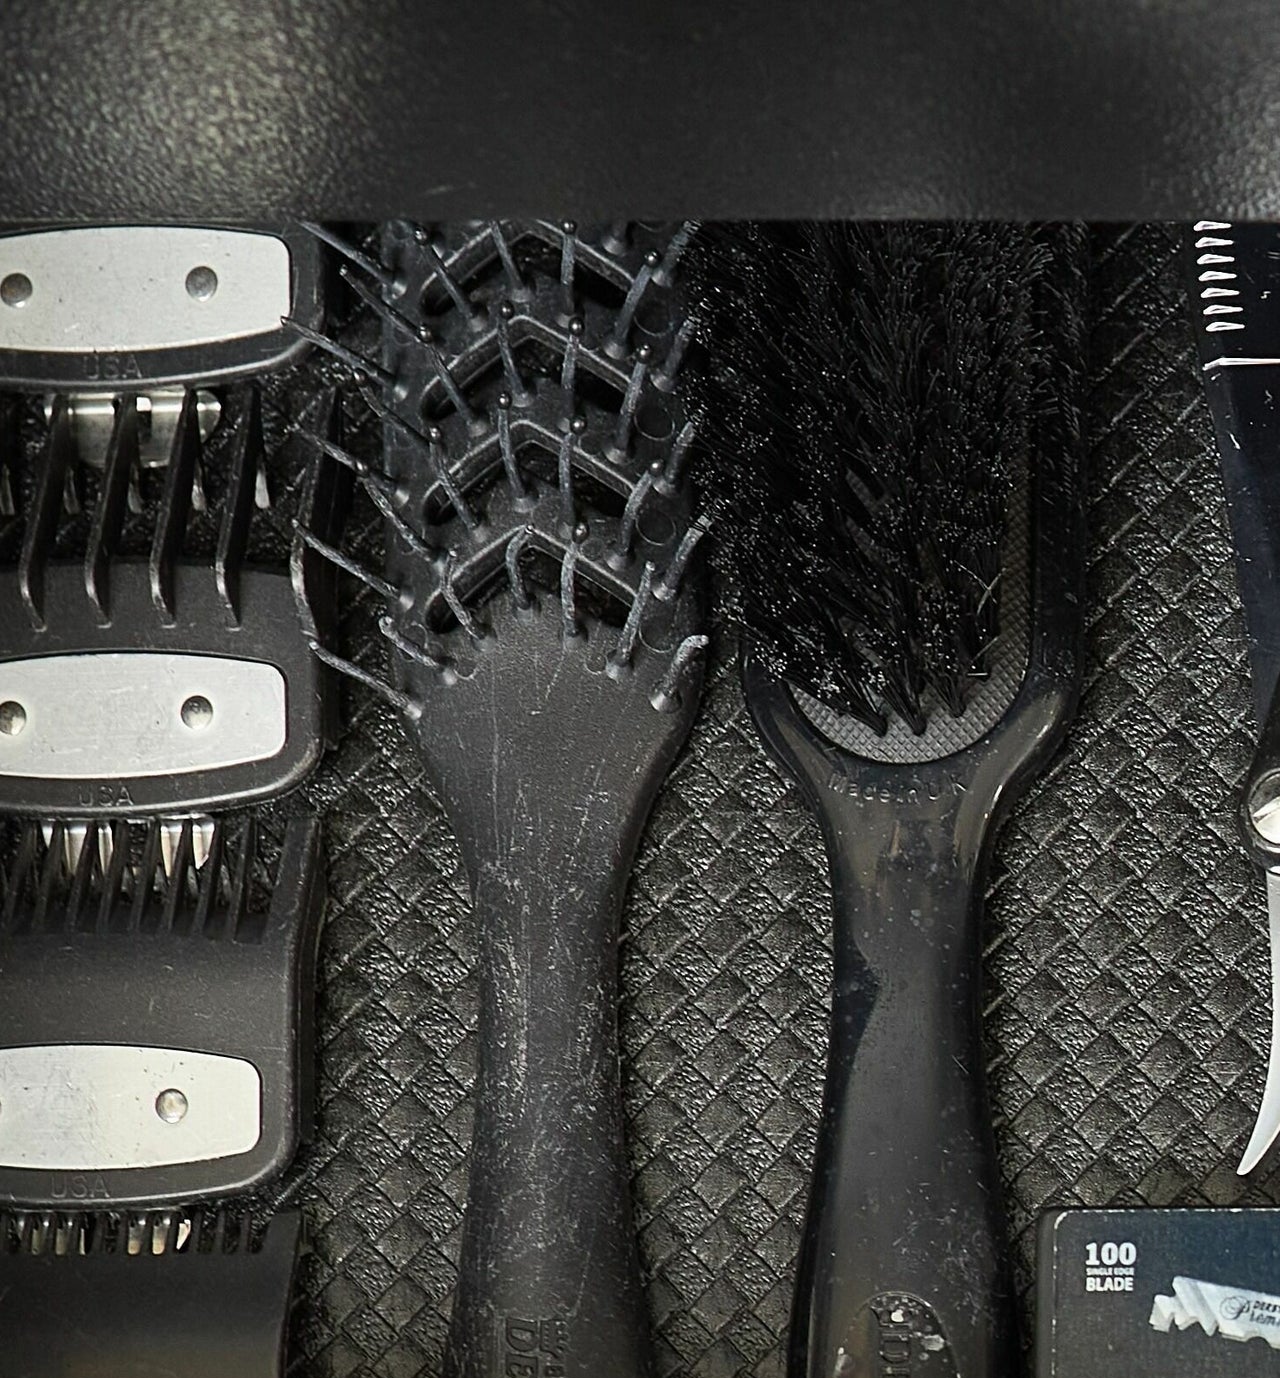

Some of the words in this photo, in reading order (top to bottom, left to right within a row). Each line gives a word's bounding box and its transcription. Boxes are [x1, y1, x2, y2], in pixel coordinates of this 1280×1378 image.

[51, 1175, 111, 1198] USA
[1085, 1242, 1137, 1266] 100
[1086, 1277, 1134, 1292] BLADE
